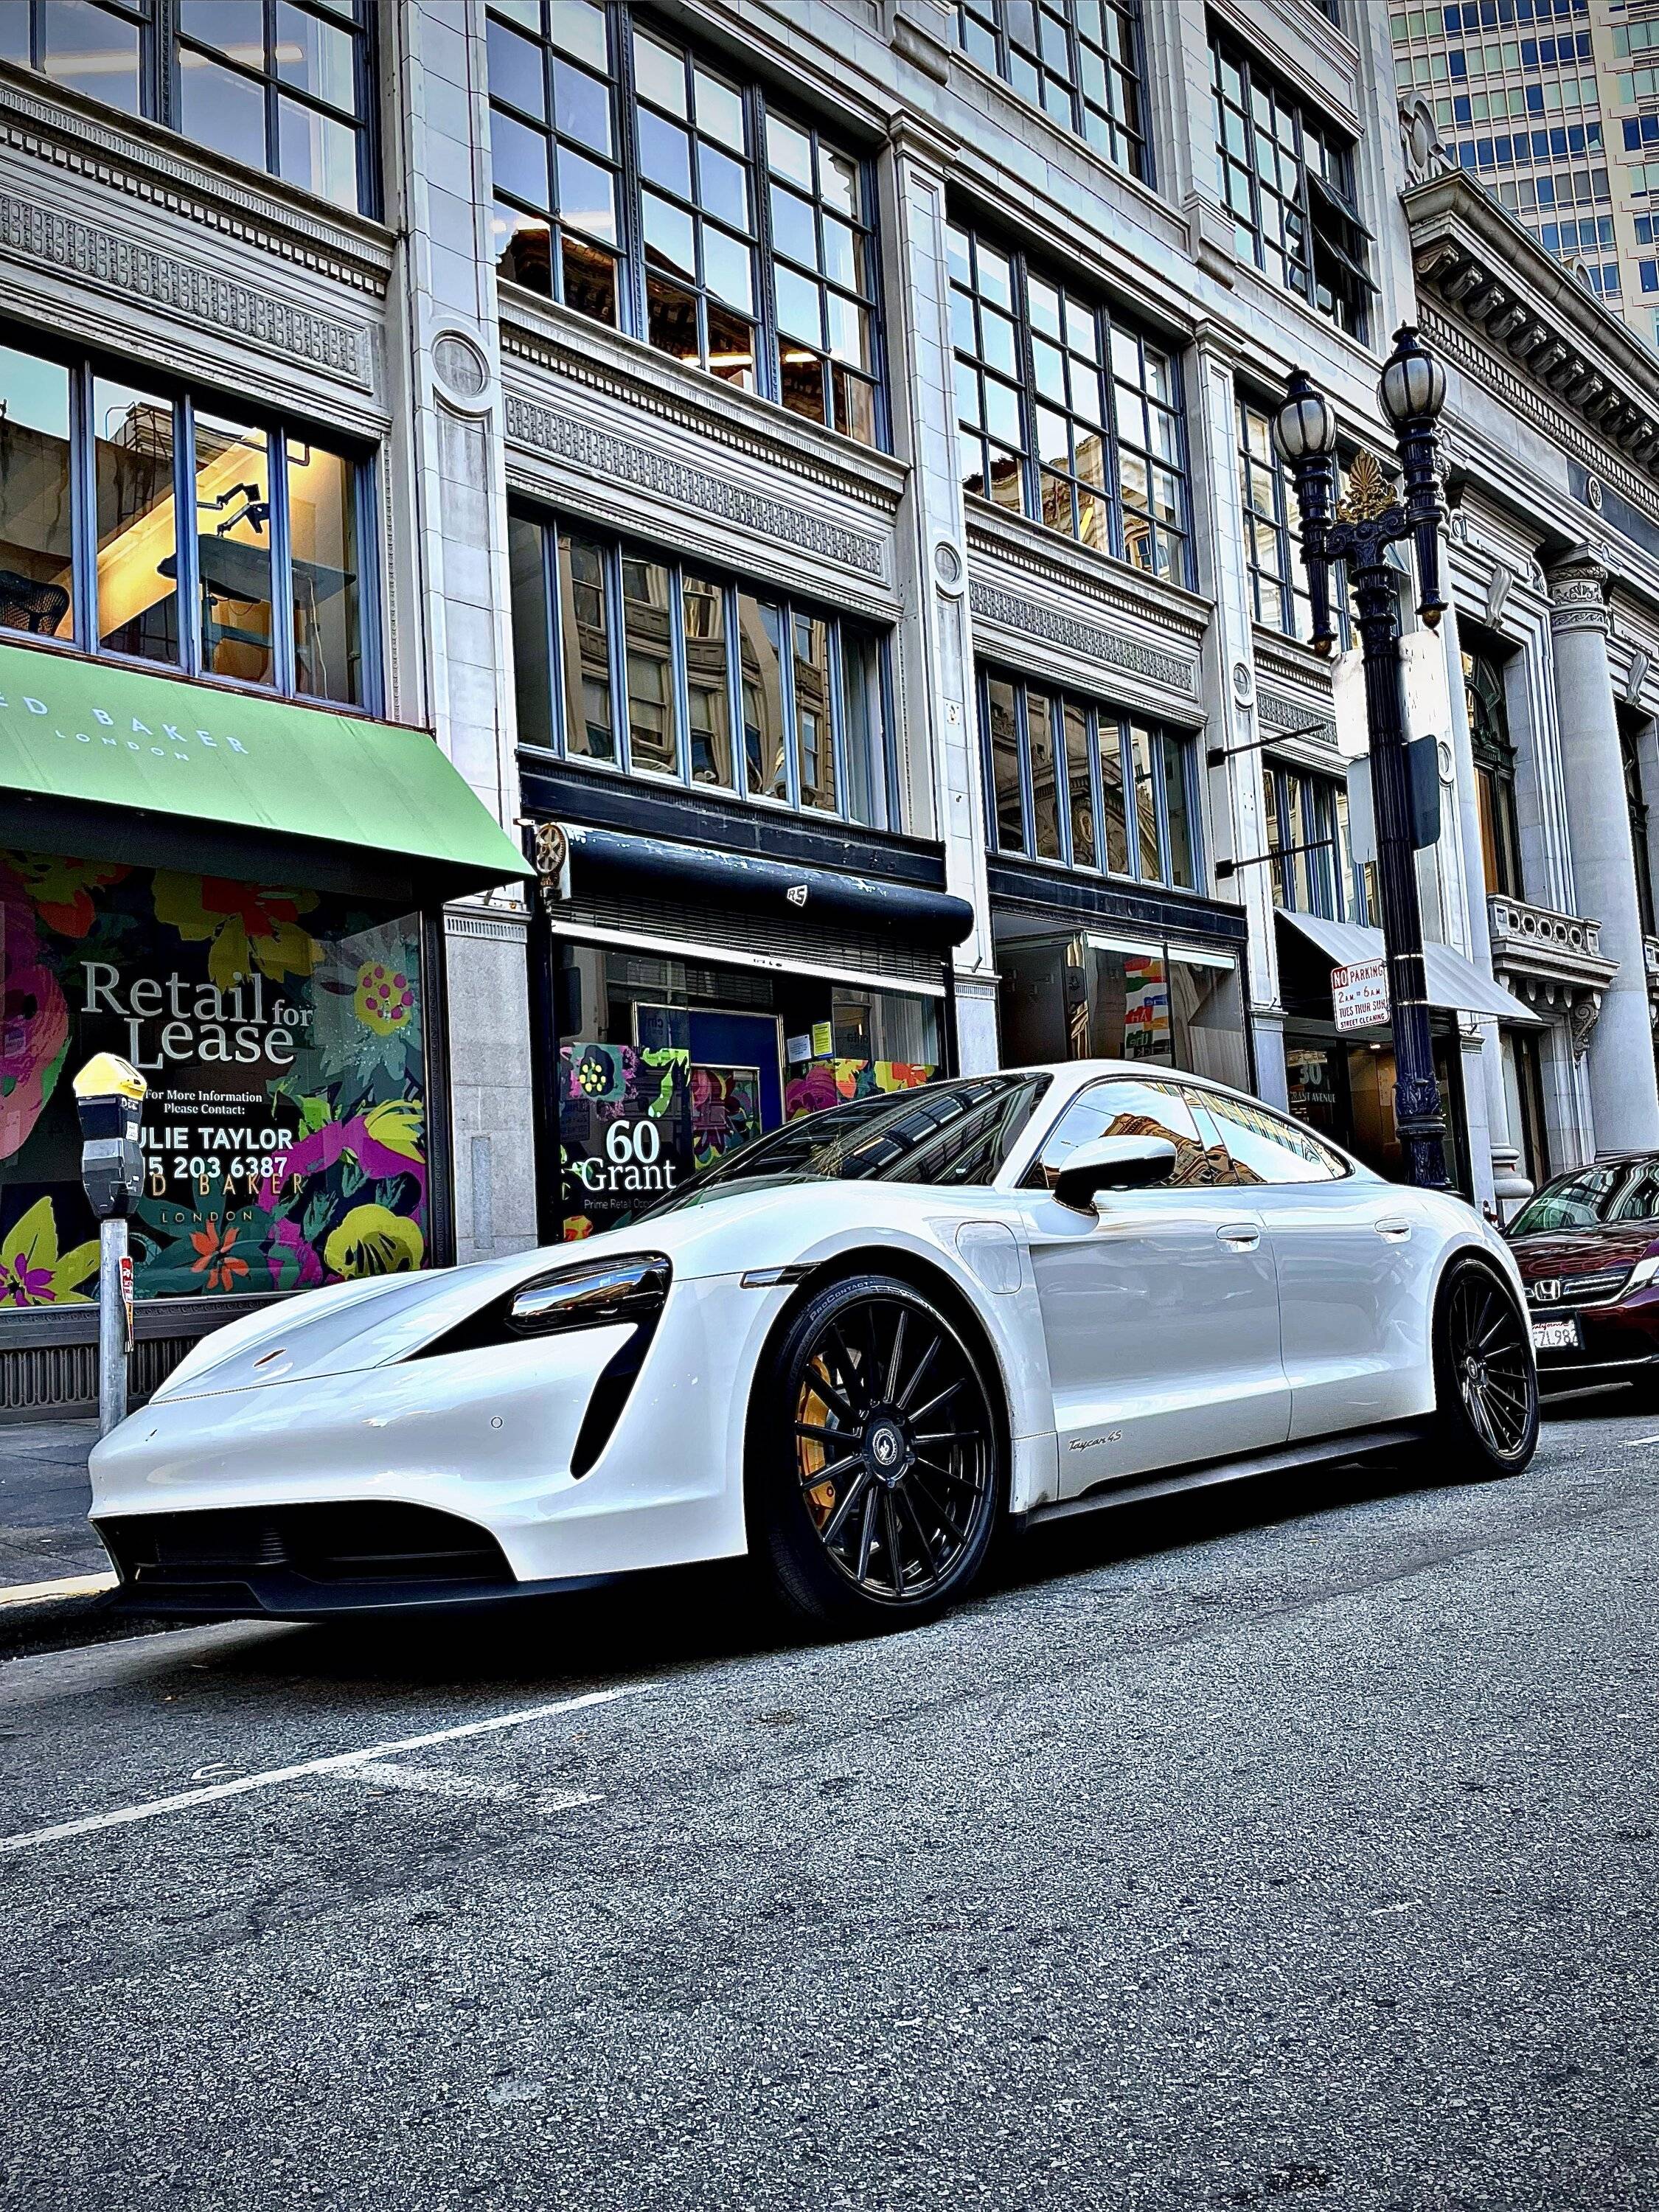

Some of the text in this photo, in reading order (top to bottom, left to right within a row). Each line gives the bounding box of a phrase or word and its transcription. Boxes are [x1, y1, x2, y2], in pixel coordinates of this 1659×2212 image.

[91, 708, 249, 754] BAKER
[55, 730, 189, 762] LONDON
[1333, 964, 1383, 988] NO PARKING
[80, 961, 314, 1027] Retail for
[1339, 1006, 1354, 1018] TUES
[1354, 1001, 1371, 1015] THUR
[1340, 1012, 1385, 1029] STREET CLEANING
[123, 1018, 294, 1069] Lease
[1299, 1063, 1322, 1085] 30
[145, 1089, 262, 1103] For More Information
[1290, 1091, 1336, 1103] RANT AVENUE
[164, 1103, 246, 1116] Please Contact:
[198, 1127, 293, 1150] TAYLOR
[606, 1119, 661, 1164] 60
[173, 1156, 221, 1179] 203
[230, 1156, 288, 1179] 6387
[581, 1157, 677, 1191] Grant
[198, 1173, 304, 1196] BAKER
[584, 1199, 608, 1209] Prime
[161, 1211, 252, 1222] LONDON
[1068, 1437, 1106, 1452] Taycan
